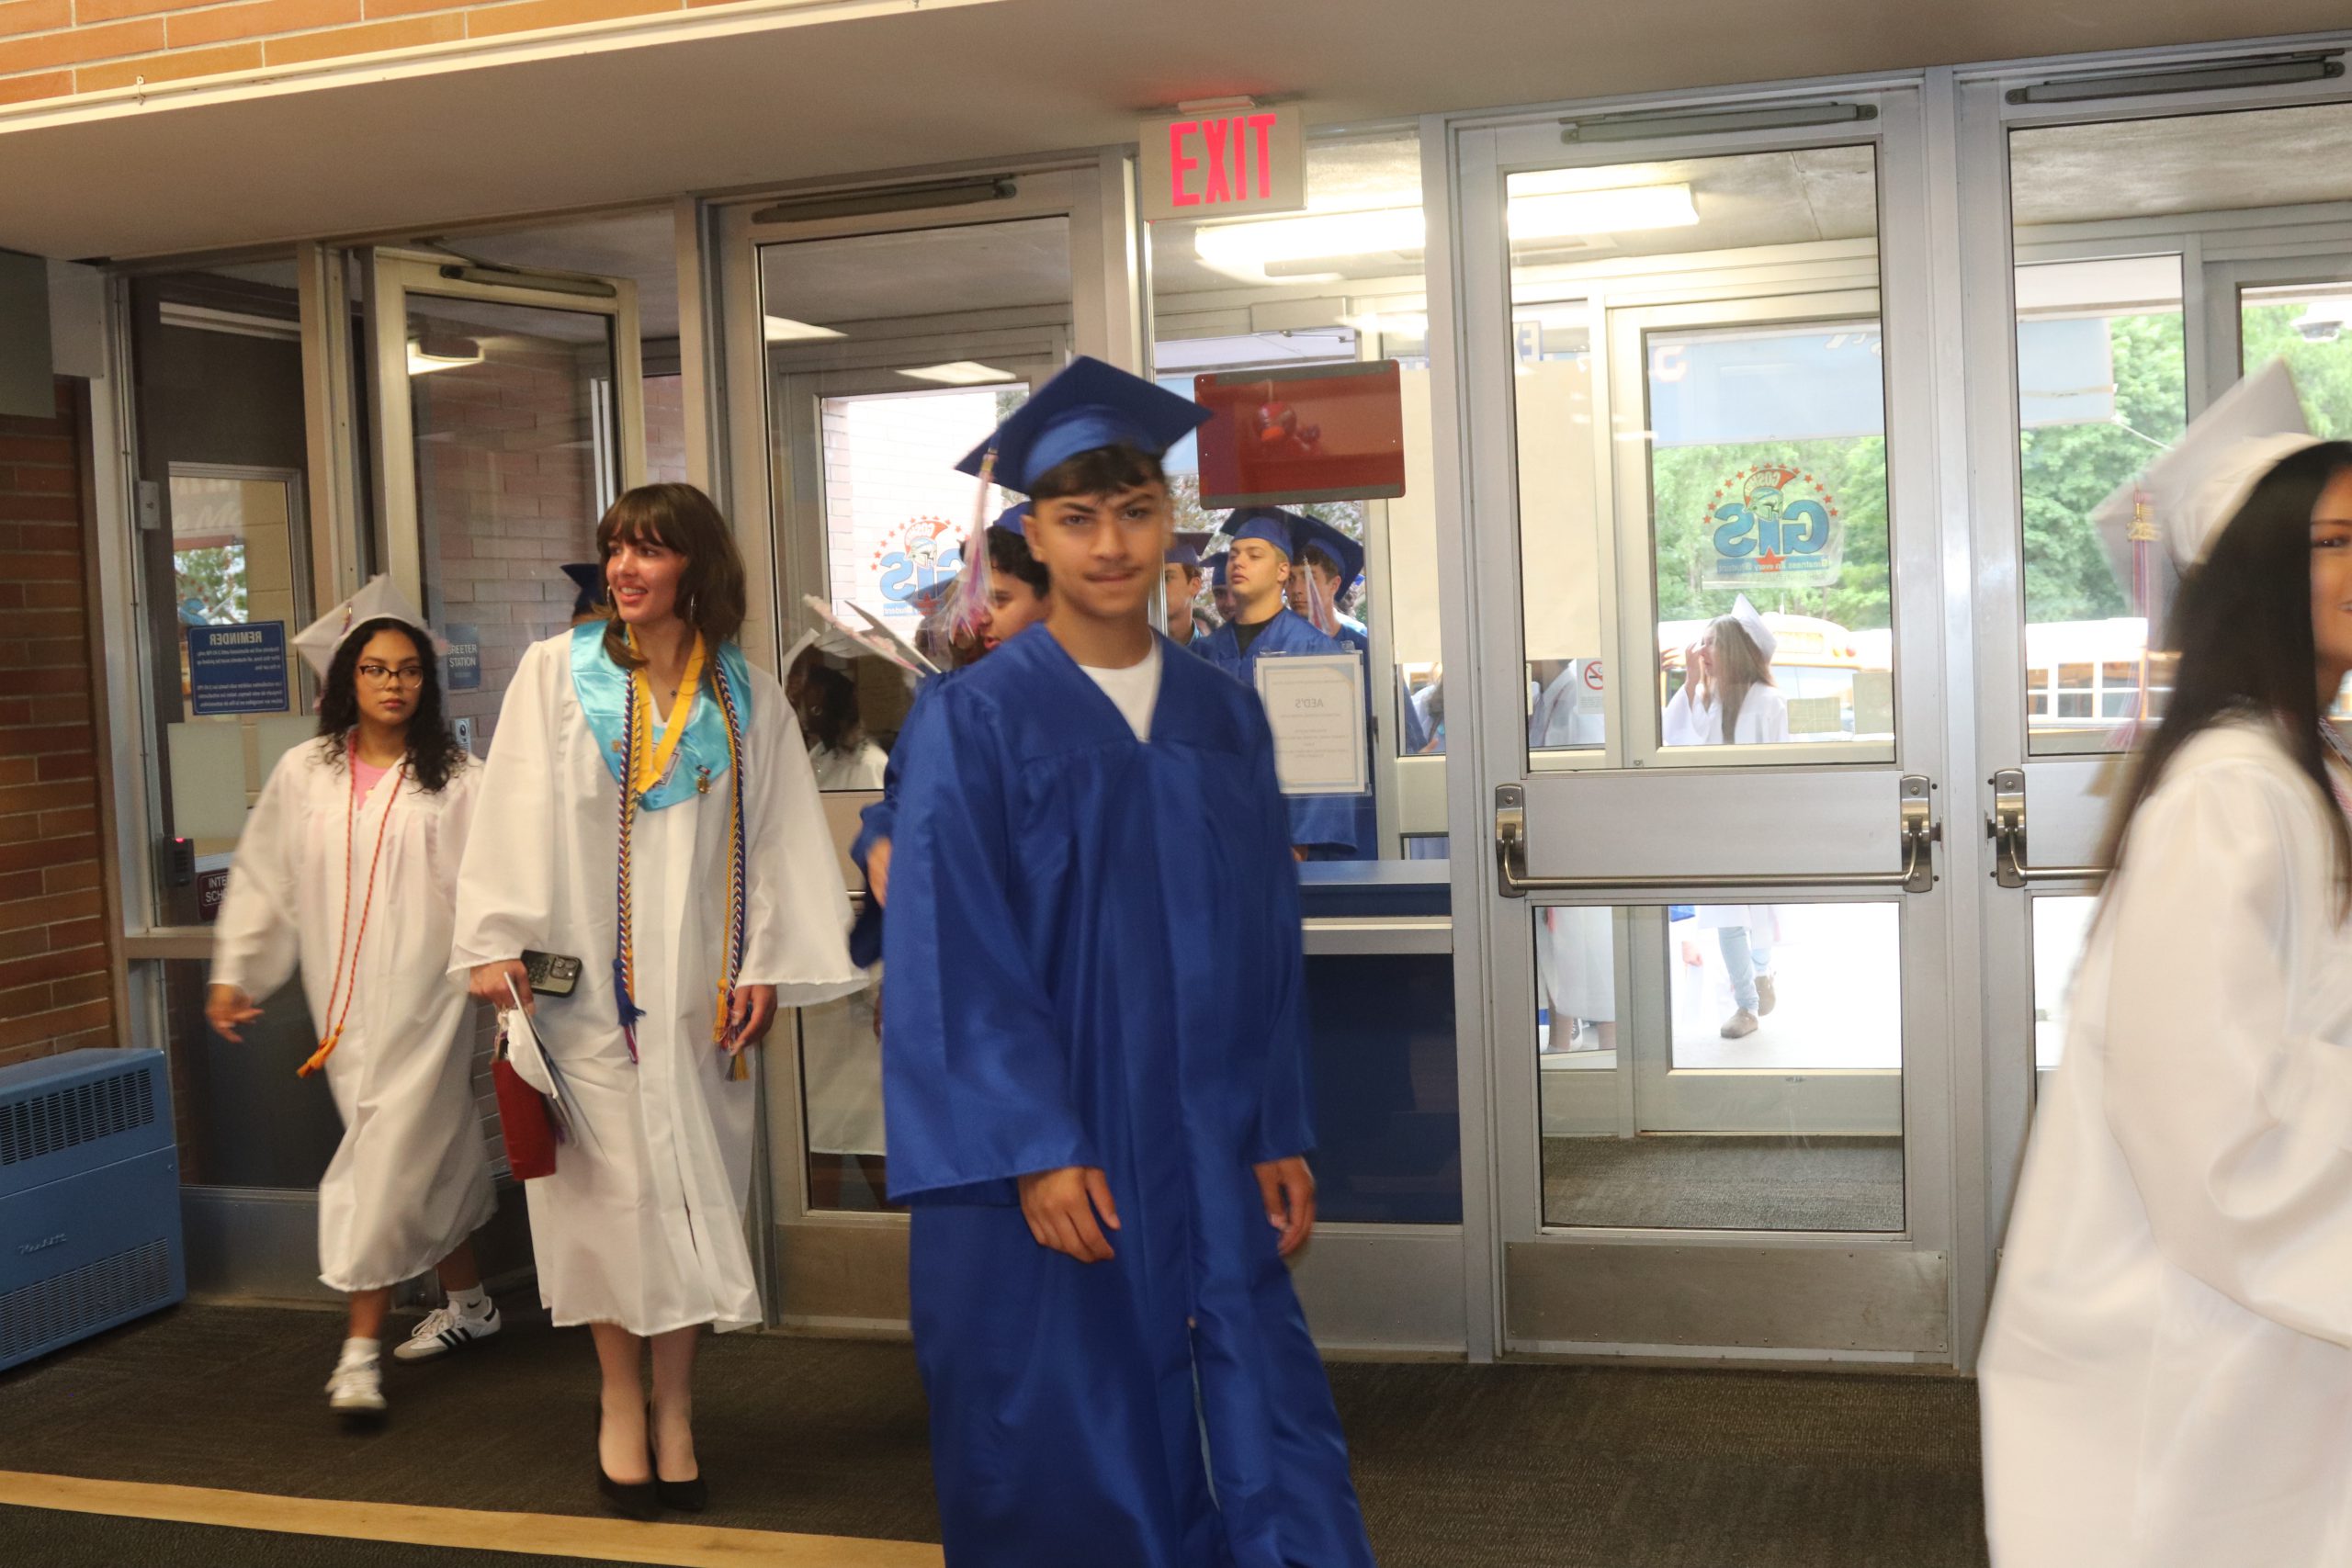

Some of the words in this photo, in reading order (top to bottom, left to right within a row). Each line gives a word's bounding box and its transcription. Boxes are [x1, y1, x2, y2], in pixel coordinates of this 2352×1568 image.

[1170, 113, 1276, 207] EXIT
[449, 656, 477, 668] STATION
[208, 876, 228, 888] INTE
